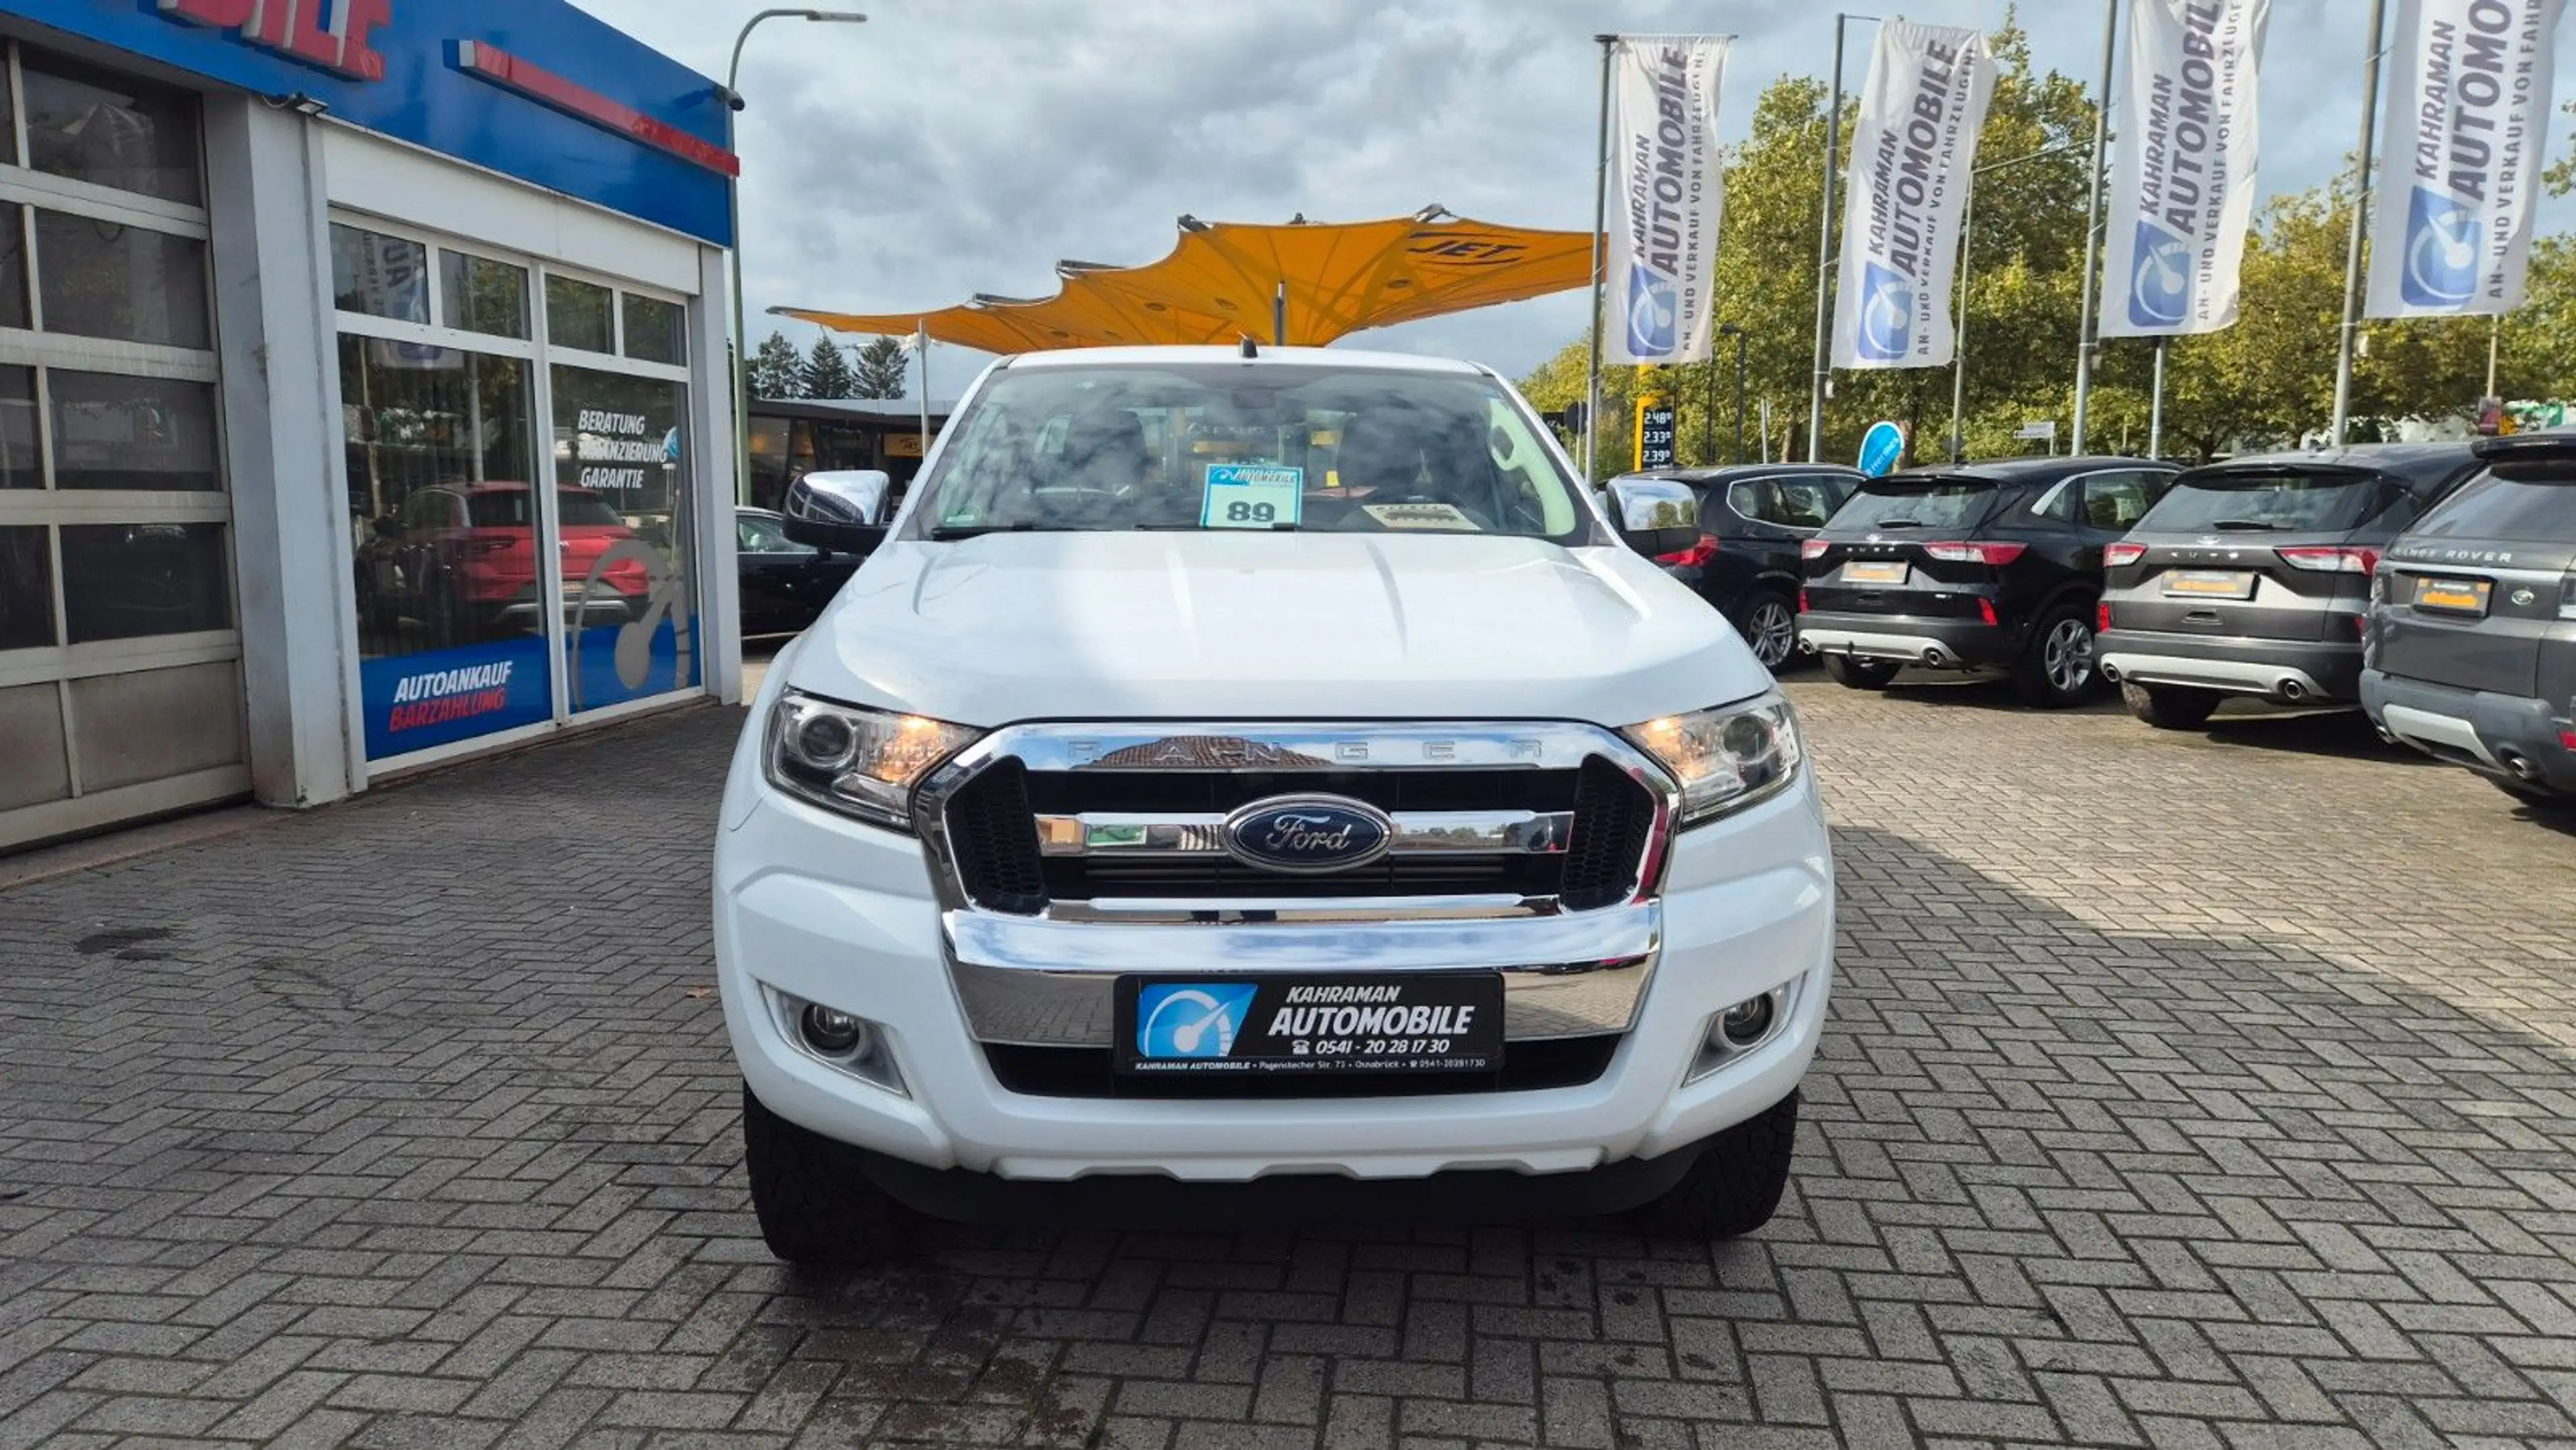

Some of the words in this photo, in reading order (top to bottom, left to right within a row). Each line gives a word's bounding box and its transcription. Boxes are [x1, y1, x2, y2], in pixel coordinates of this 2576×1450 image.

[2415, 19, 2456, 180] KAHRAMAN
[2448, 0, 2512, 202] AUTOMO
[2512, 60, 2533, 105] VON
[2140, 73, 2173, 216] KAHRAMAN
[2216, 113, 2231, 152] VON
[1651, 46, 1689, 277] AUTOMOBILE
[1890, 40, 1957, 278] AUTOMOBILE
[2496, 114, 2526, 209] VERKAUF
[1632, 133, 1651, 259] KAHRAMAN
[1690, 170, 1703, 205] VON
[1868, 129, 1898, 256] KAHRAMAN
[1929, 174, 1946, 209] VON
[2204, 158, 2227, 240] VERKAUF
[1405, 239, 1529, 258] JET
[1686, 210, 1700, 284] VERKAUF
[1921, 214, 1937, 286] VERKAUF
[2493, 217, 2510, 256] UND
[2200, 247, 2214, 283] UND
[1684, 287, 1695, 319] UND
[1920, 292, 1931, 322] UND
[578, 409, 645, 435] BERATUNG
[578, 439, 668, 463] ANZIERUNG
[580, 467, 645, 489] GARANTIE
[1227, 501, 1275, 522] 89
[2445, 549, 2513, 563] ROVER
[393, 660, 513, 704] AUTOANKAUF
[388, 686, 506, 733] BARZAHLUNG
[1068, 738, 1542, 763] RANGER
[1265, 814, 1351, 851] Ford
[1286, 985, 1402, 1003] KAHRAMAN
[1267, 1005, 1475, 1036] AUTOMOBILE
[1134, 1062, 1189, 1070] KAHRAMAN
[1189, 1062, 1250, 1070] AUTOMOBILE
[1315, 1040, 1353, 1055] 0541
[1364, 1040, 1386, 1054] 20
[1387, 1040, 1408, 1054] 28
[1411, 1040, 1428, 1054] 17
[1428, 1040, 1450, 1054] 30
